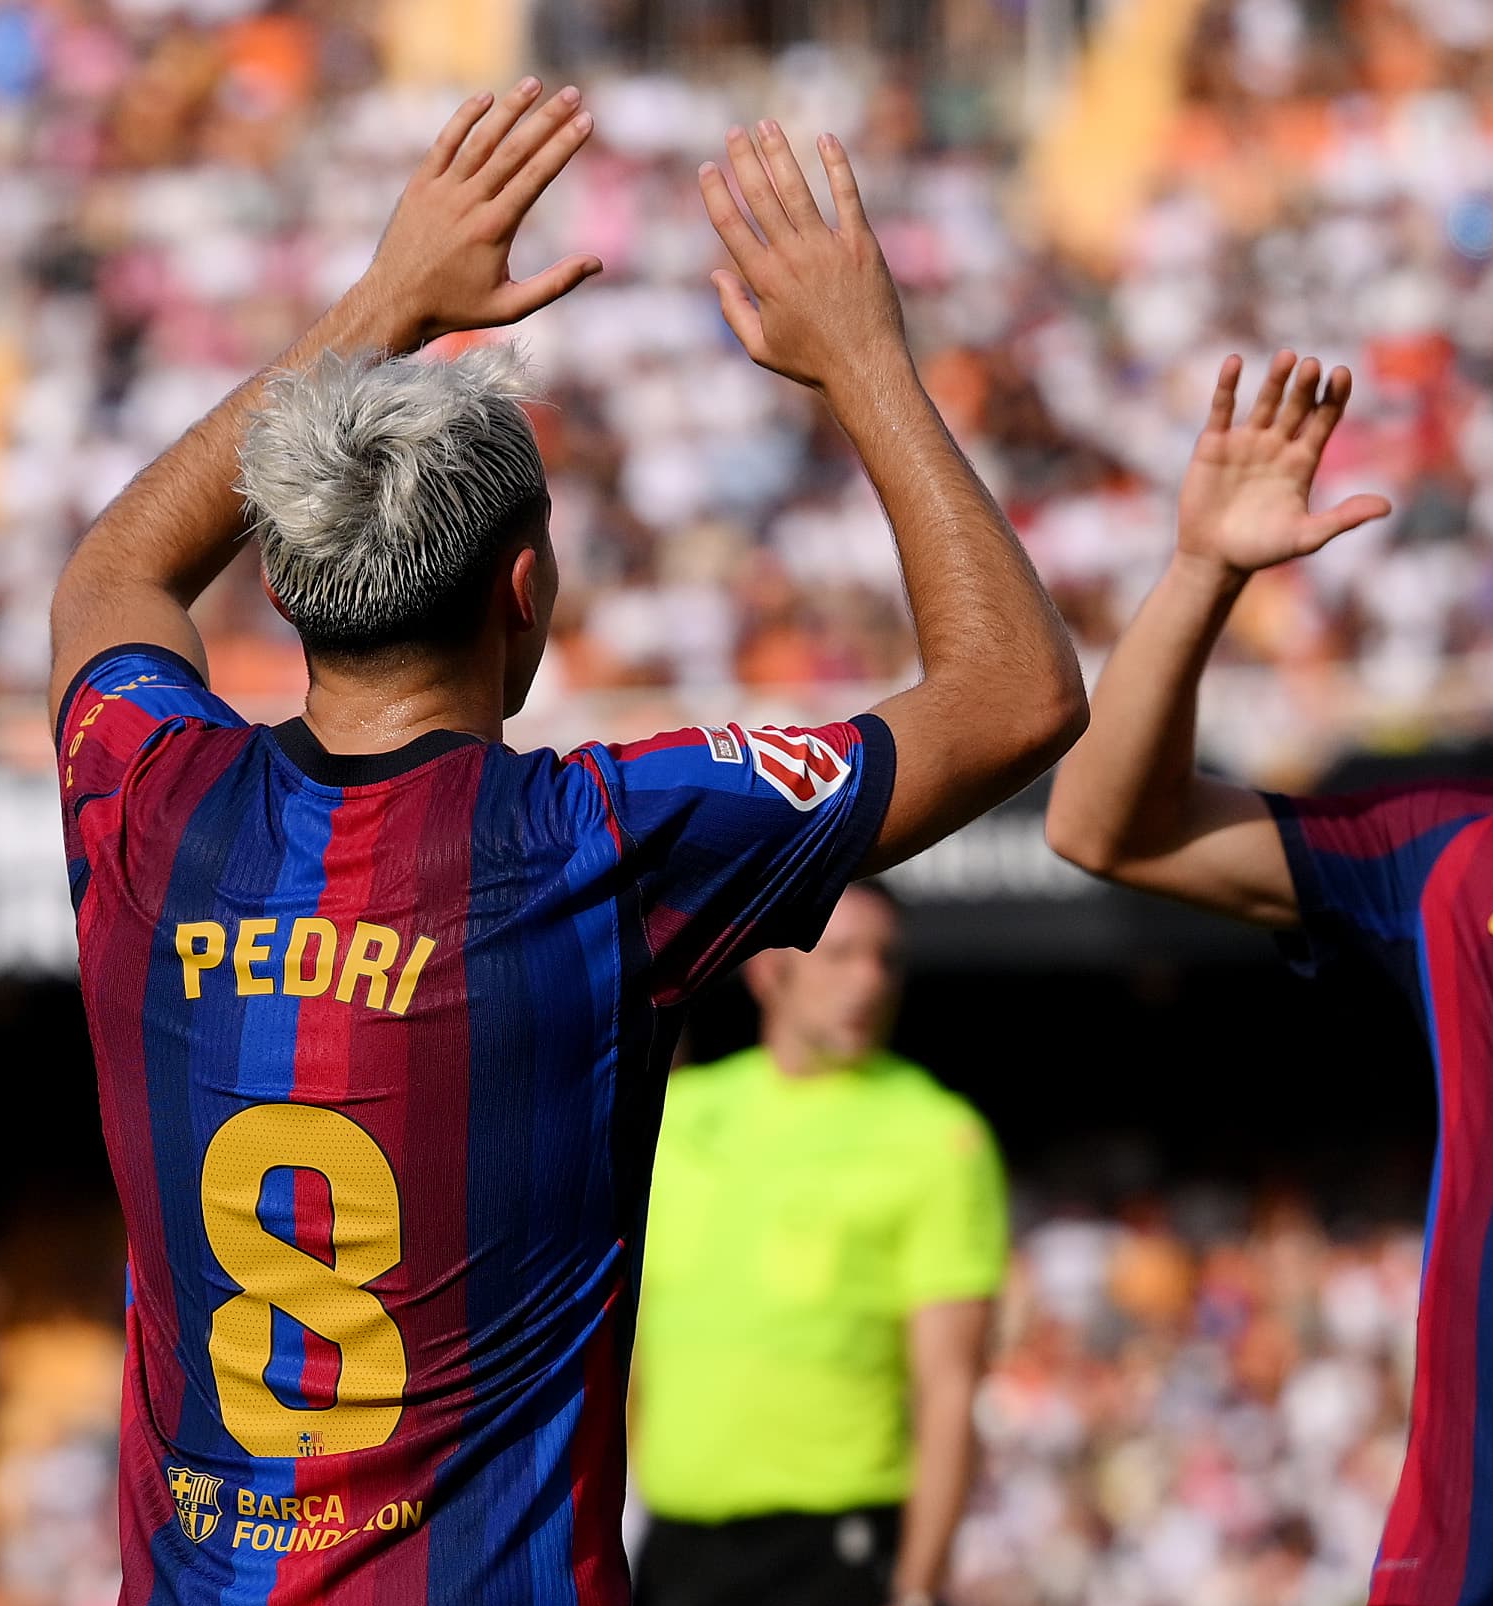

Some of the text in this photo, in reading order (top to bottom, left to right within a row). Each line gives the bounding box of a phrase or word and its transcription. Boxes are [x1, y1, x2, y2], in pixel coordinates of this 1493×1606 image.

[175, 917, 437, 1016] PEDRI
[201, 1103, 407, 1458] 8
[237, 1488, 345, 1529] BARÇA
